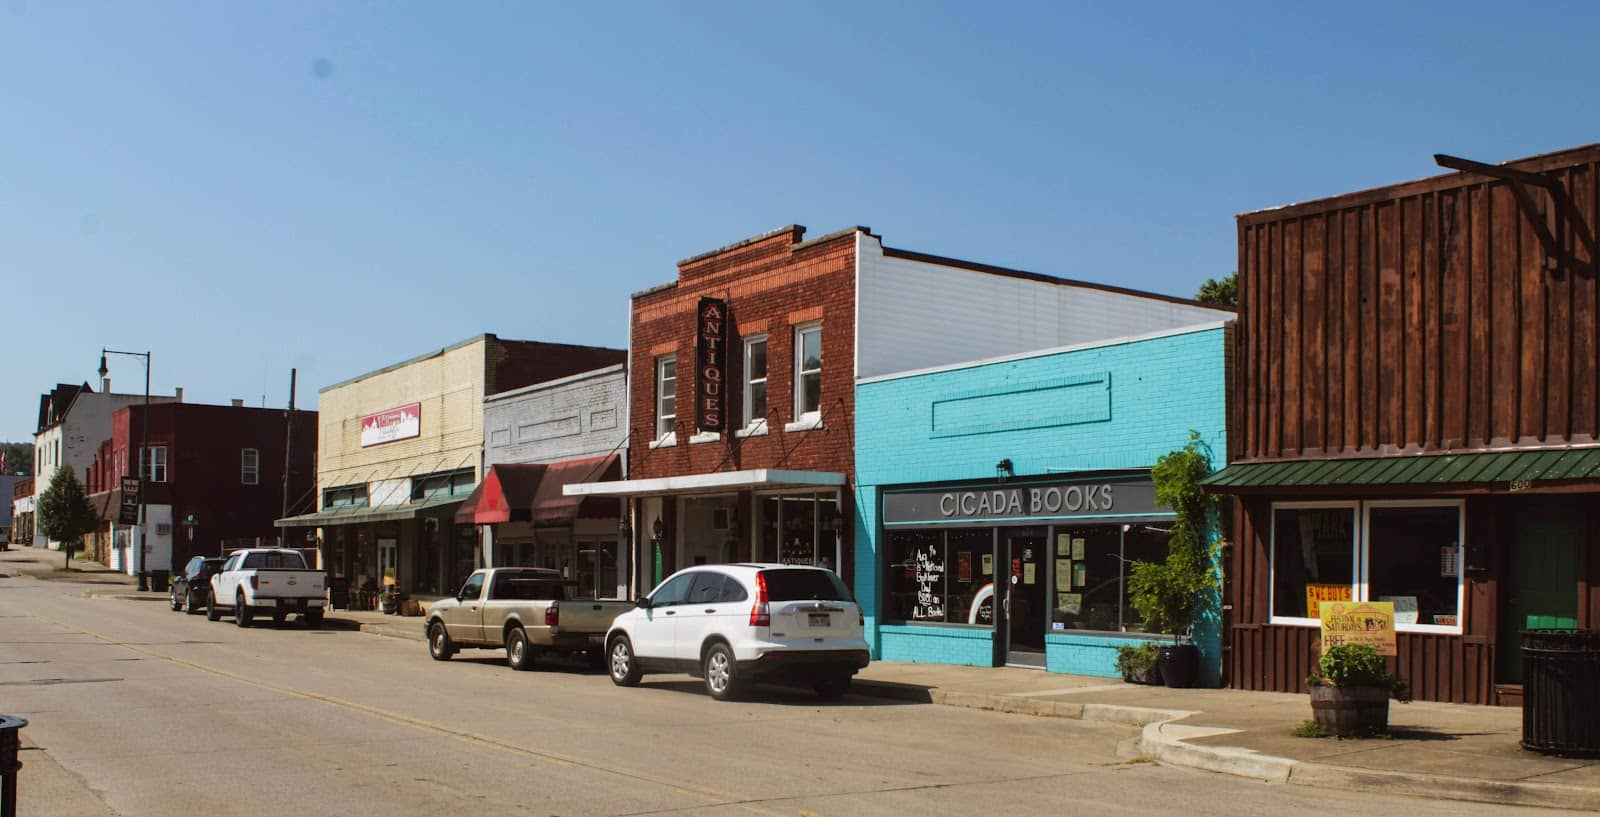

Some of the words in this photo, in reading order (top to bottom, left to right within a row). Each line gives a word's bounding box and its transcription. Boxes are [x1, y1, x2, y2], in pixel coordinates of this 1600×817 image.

[704, 304, 721, 426] ANTIQUES
[1511, 480, 1530, 490] 600
[940, 489, 1024, 517] CICADA
[1031, 484, 1114, 513] BOOKS
[782, 557, 812, 565] ANTIQUES
[1315, 585, 1326, 600] WE
[1328, 585, 1343, 600] BUY
[912, 605, 927, 620] ALL
[1324, 635, 1345, 646] FREE
